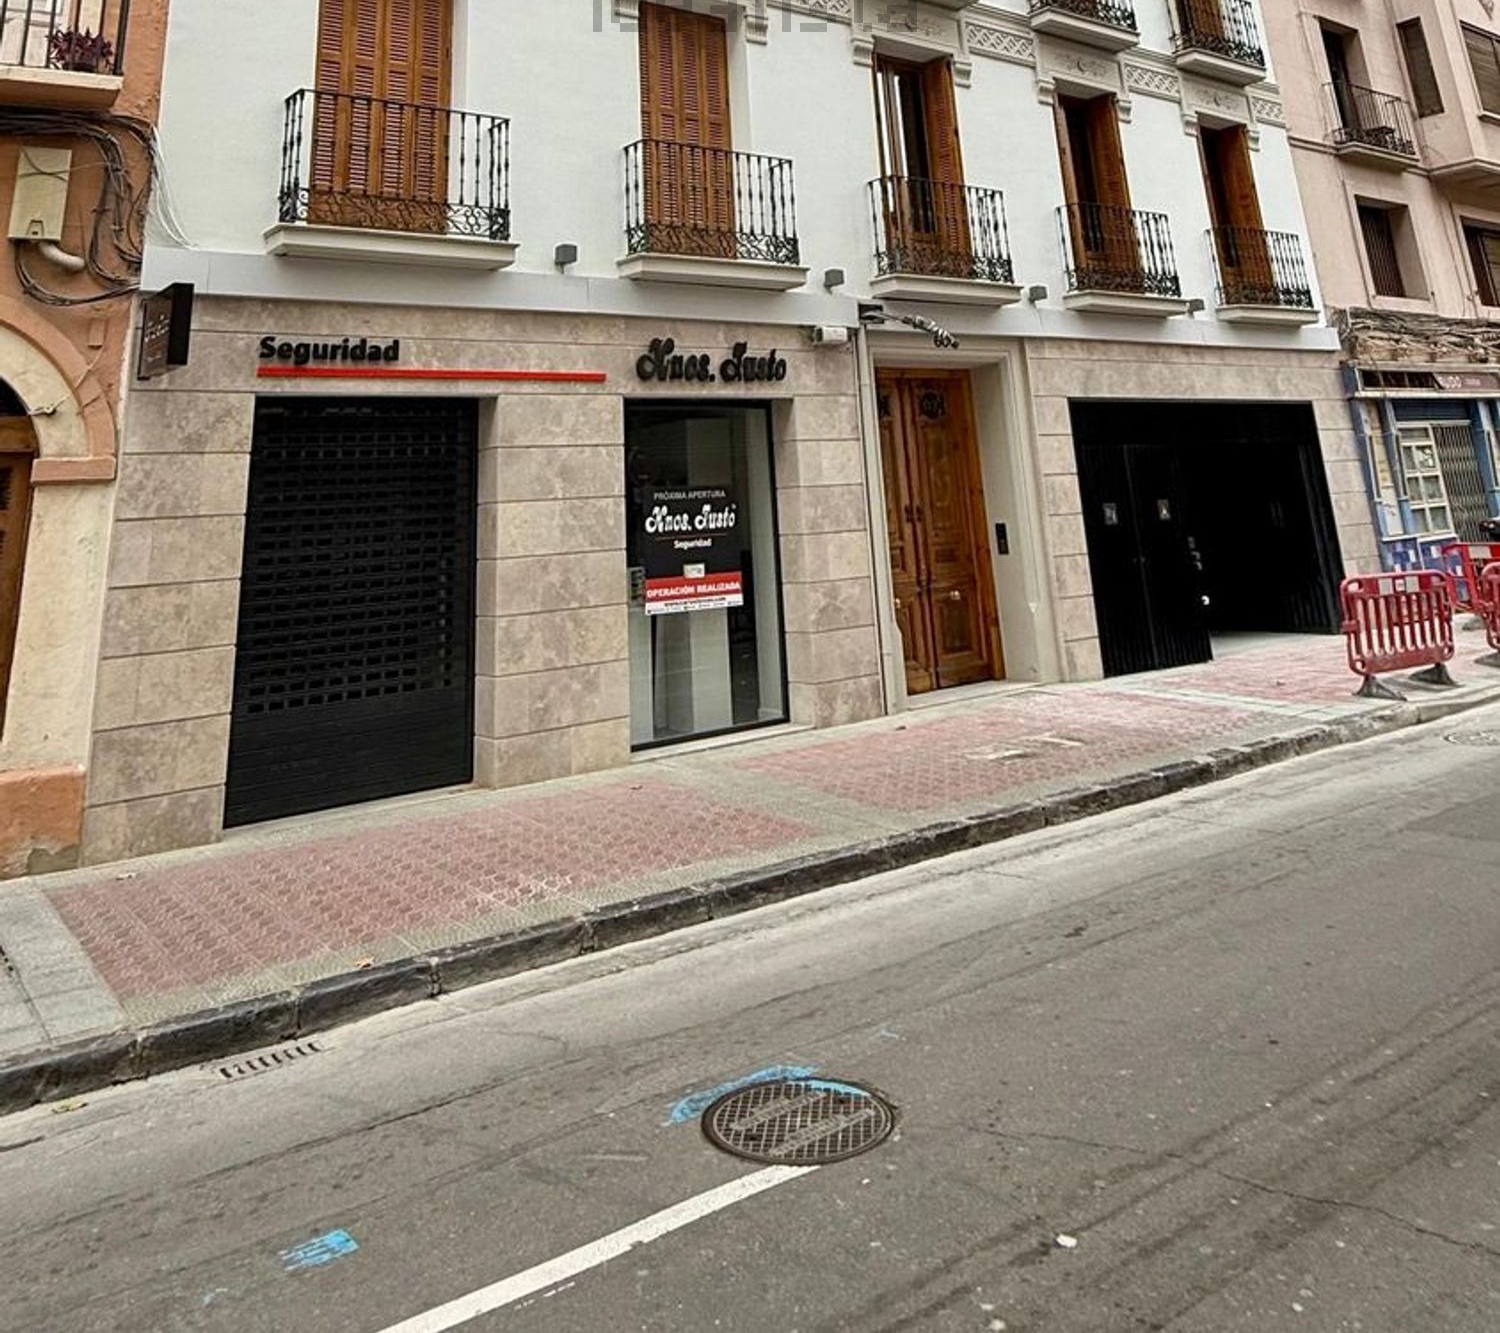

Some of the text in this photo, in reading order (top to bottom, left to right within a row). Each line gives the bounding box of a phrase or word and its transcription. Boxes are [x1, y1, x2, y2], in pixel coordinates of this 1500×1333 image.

[259, 336, 399, 365] Seguridad
[720, 341, 787, 382] Justo
[688, 489, 726, 500] APERTURA
[694, 504, 735, 530] Justo
[673, 538, 712, 550] Seguridad
[646, 581, 740, 598] OPERACIÓN REALIZADA
